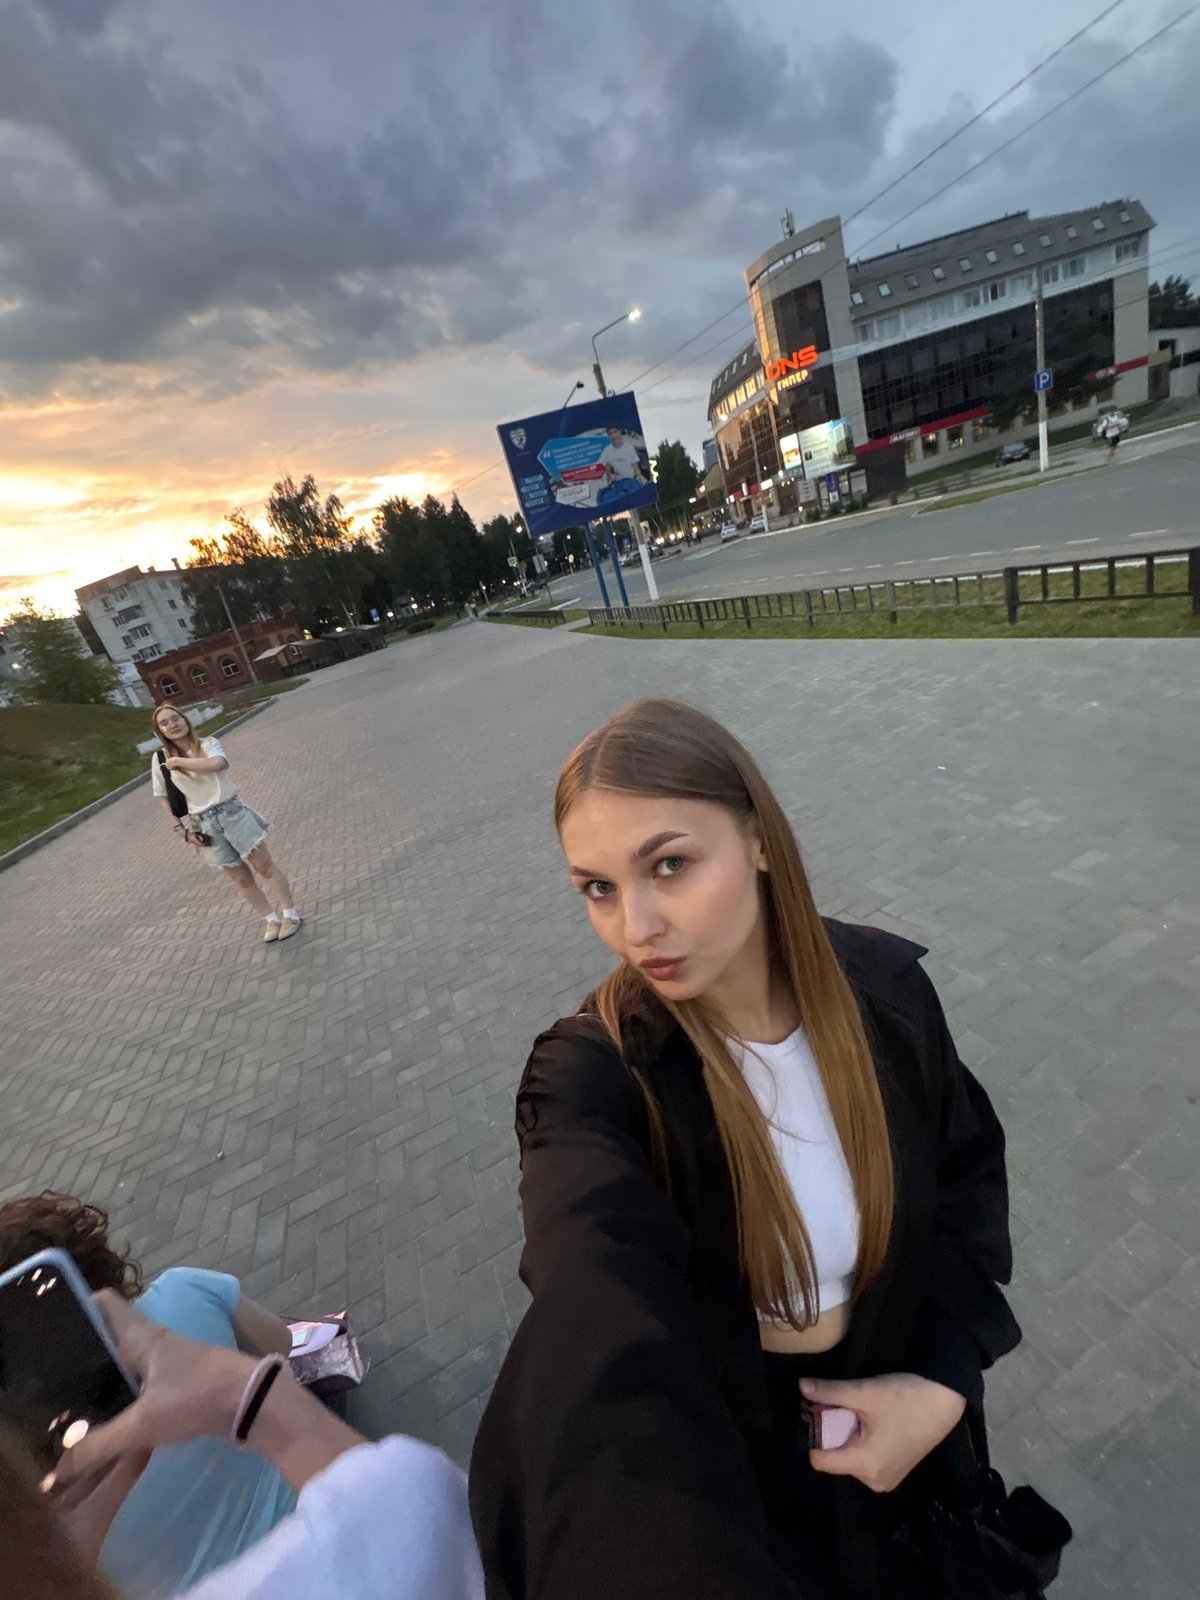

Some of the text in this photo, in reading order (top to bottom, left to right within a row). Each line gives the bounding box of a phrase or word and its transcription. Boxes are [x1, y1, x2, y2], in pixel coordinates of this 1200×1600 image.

[766, 344, 819, 381] DNS
[777, 369, 808, 390] ГИПЕР
[1040, 372, 1049, 389] P
